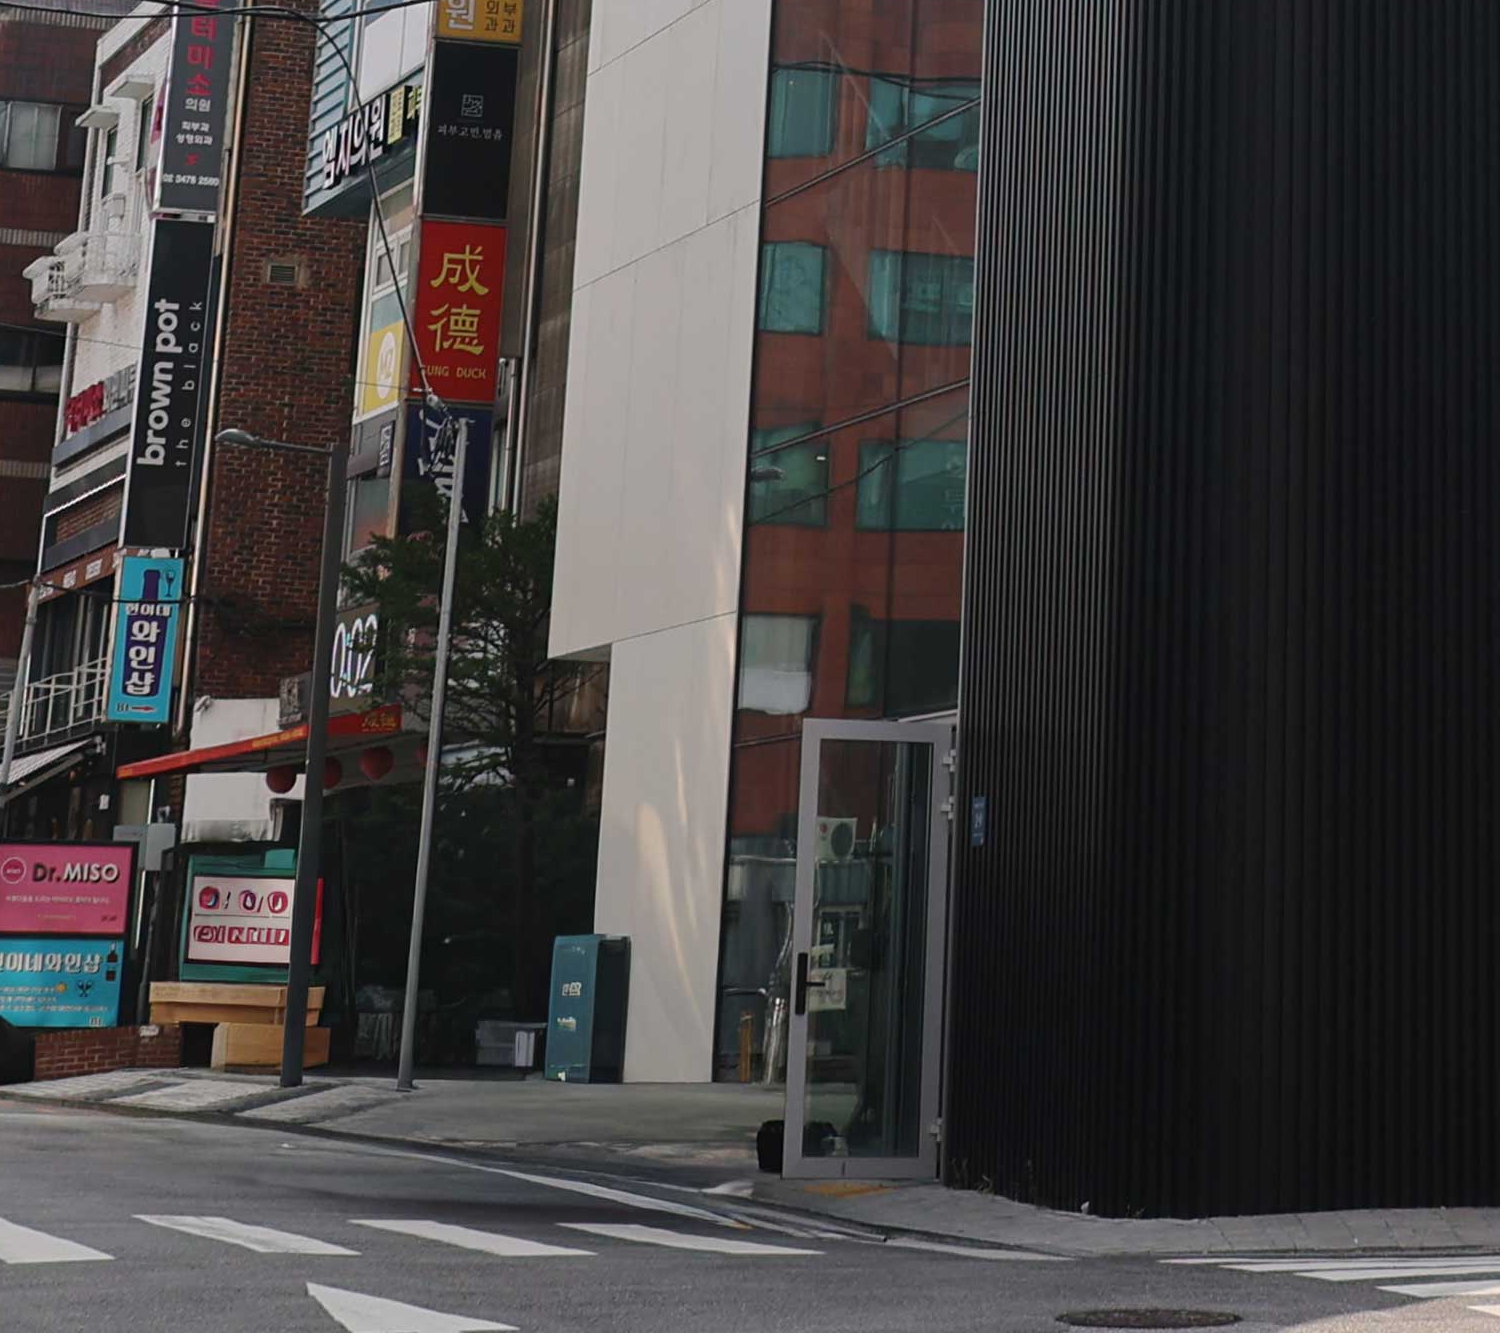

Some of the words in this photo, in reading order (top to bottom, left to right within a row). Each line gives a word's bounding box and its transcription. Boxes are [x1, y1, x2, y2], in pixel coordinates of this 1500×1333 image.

[185, 97, 211, 112] 의원
[176, 133, 213, 146] 성형외과
[182, 121, 210, 133] 피부과
[428, 244, 489, 356] 成德
[155, 299, 183, 354] pot
[456, 365, 487, 379] DUCK
[137, 362, 174, 466] brown
[176, 417, 192, 467] the
[125, 619, 160, 694] 와인샵
[32, 862, 120, 884] Dr.MISO
